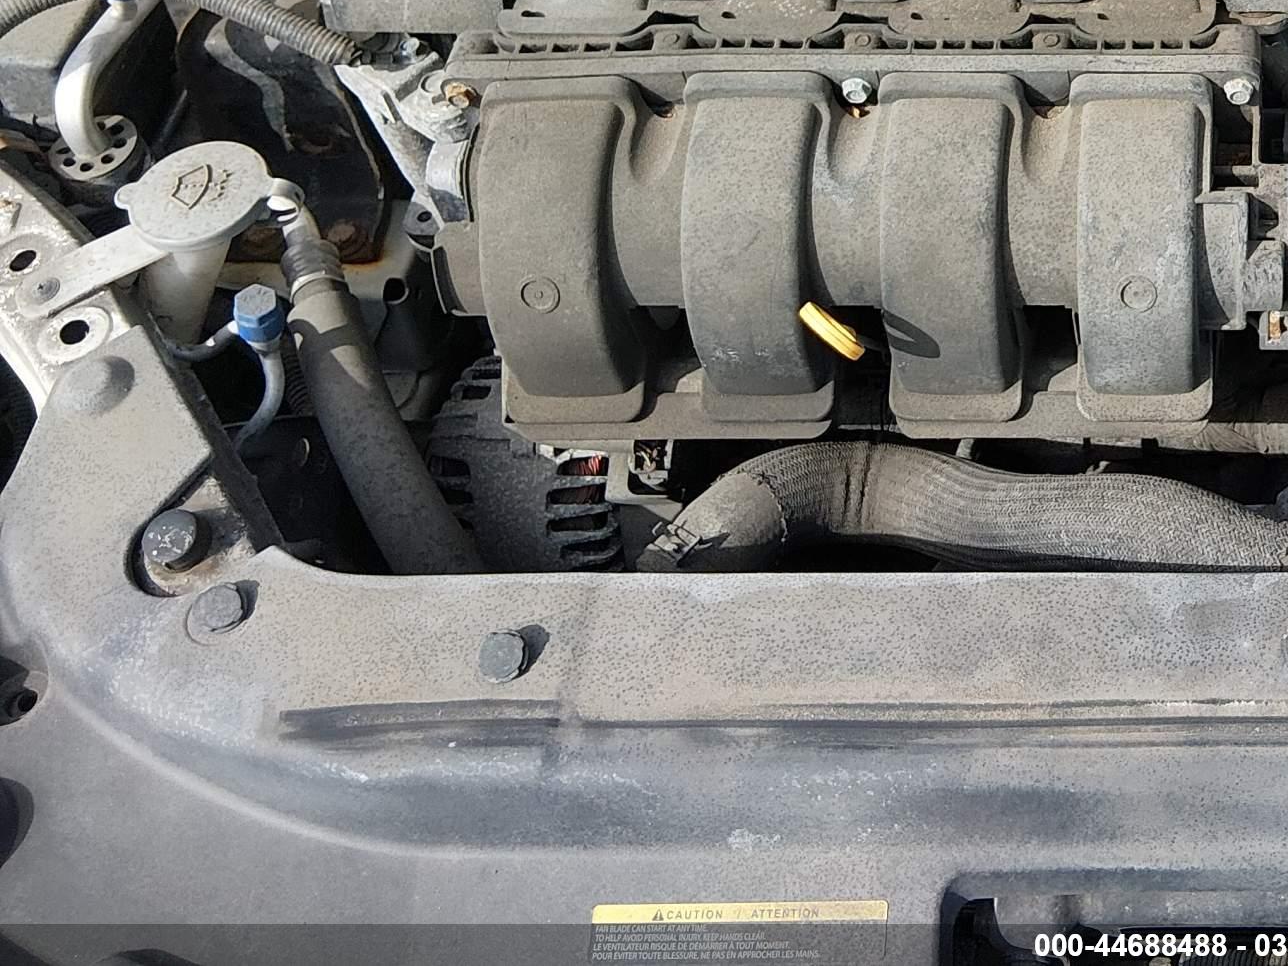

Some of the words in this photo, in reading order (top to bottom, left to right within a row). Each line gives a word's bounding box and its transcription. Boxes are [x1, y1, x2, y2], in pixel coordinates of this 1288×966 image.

[667, 909, 723, 920] CAUTION
[751, 908, 820, 919] ATTENTION
[595, 924, 609, 933] FAN
[610, 924, 631, 933] BLADE
[631, 924, 645, 933] CAN
[646, 924, 667, 933] START
[667, 924, 676, 933] AT
[676, 924, 690, 933] ANY
[595, 933, 604, 942] TO
[605, 933, 621, 942] HELP
[622, 933, 642, 942] AVOID
[643, 933, 678, 942] PERSONAL
[703, 933, 719, 942] KEEP
[720, 933, 743, 942] HANDS
[593, 942, 602, 951] LE
[602, 942, 649, 951] VENTILATEUR
[650, 942, 676, 951] RISQUE
[677, 942, 688, 951] DE
[736, 942, 755, 951] TOUT
[592, 950, 612, 960] POUR
[638, 950, 661, 960] TOUTE
[701, 950, 711, 960] NE
[712, 950, 725, 960] PAS
[727, 950, 736, 960] EN
[737, 950, 781, 960] APPROCHER
[781, 950, 794, 960] LES
